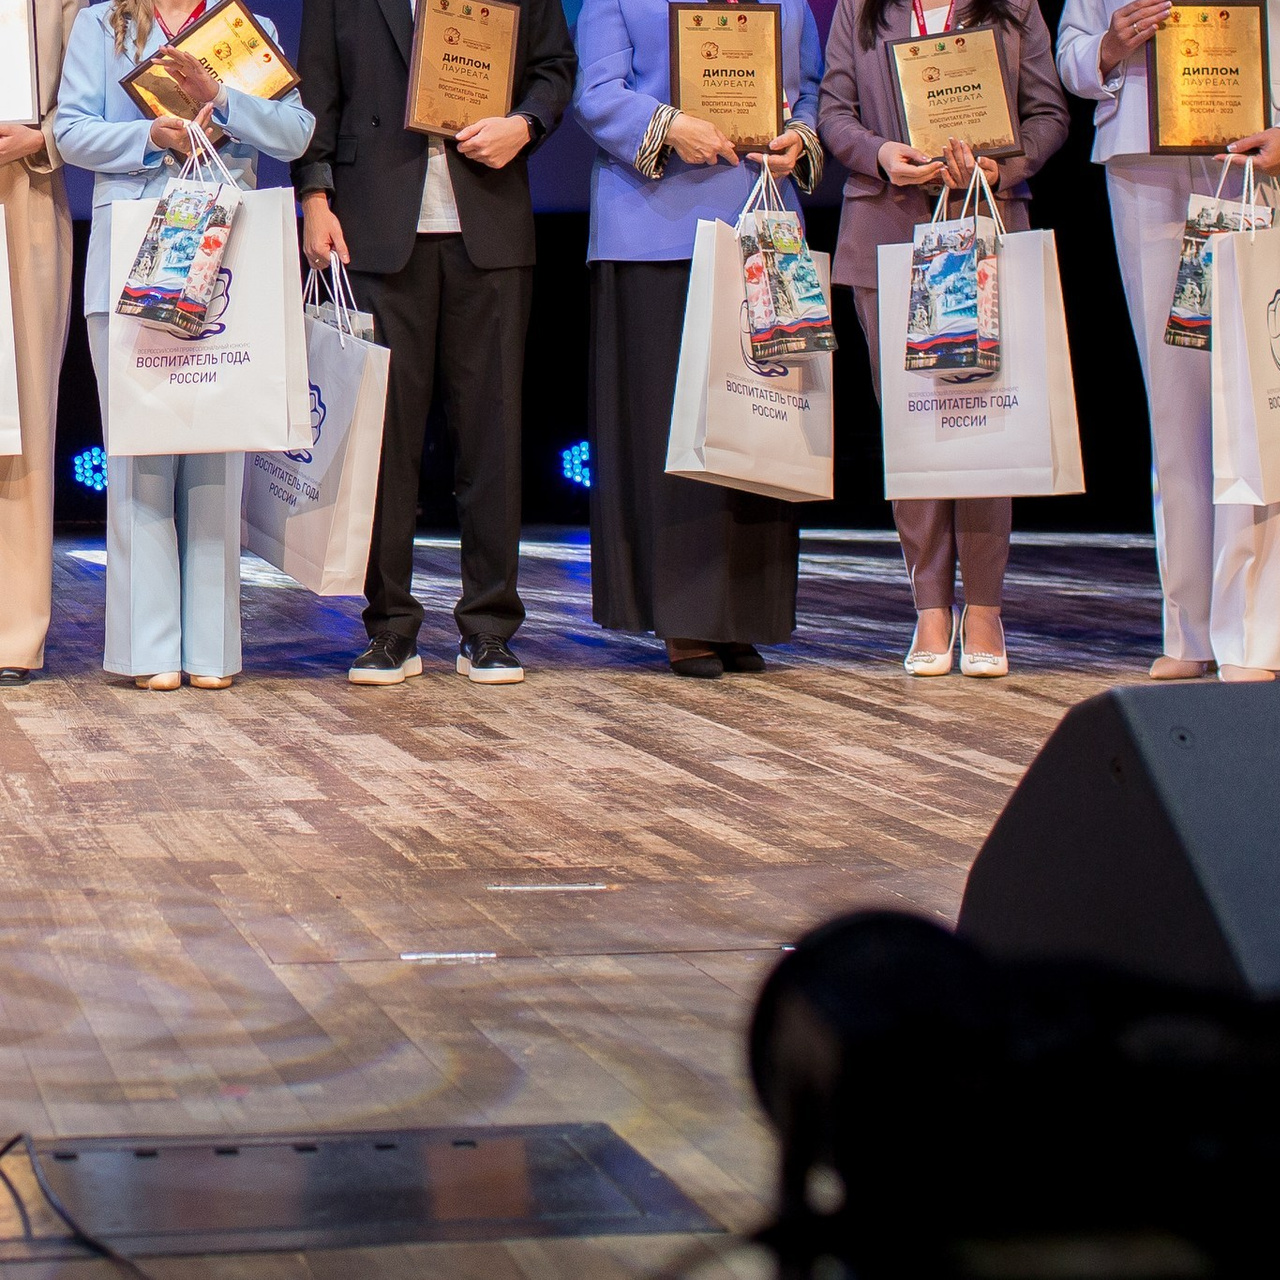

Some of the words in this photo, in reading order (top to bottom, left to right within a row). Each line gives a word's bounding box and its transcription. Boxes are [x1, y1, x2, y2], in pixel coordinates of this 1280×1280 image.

[199, 57, 224, 83] ДИП
[442, 53, 491, 71] ДИПЛОМ
[441, 64, 490, 80] ЛАУРЕАТА
[702, 69, 755, 78] ДИПЛОМ
[1182, 68, 1240, 76] ДИПЛОМ
[702, 80, 756, 88] ЛАУРЕАТА
[1182, 78, 1240, 86] ЛАУРЕАТА
[926, 82, 982, 100] ДИПЛОМ
[928, 92, 984, 107] ЛАУРЕАТА
[136, 354, 218, 368] ВОСПИТАТЕЛЬ
[220, 351, 250, 365] ГОДА
[170, 372, 216, 384] РОССИИ
[726, 380, 786, 404] ВОСПИТАТЕЛЬ
[787, 395, 810, 412] ГОДА
[908, 397, 988, 412] ВОСПИТАТЕЛЬ
[990, 395, 1019, 410] ГОДА
[752, 404, 788, 422] РОССИИ
[942, 415, 987, 428] РОССИИ
[254, 454, 301, 490] ВОСПИТАТЕЛЬ
[302, 482, 320, 502] ГОДА
[268, 482, 298, 507] РОССИИ
